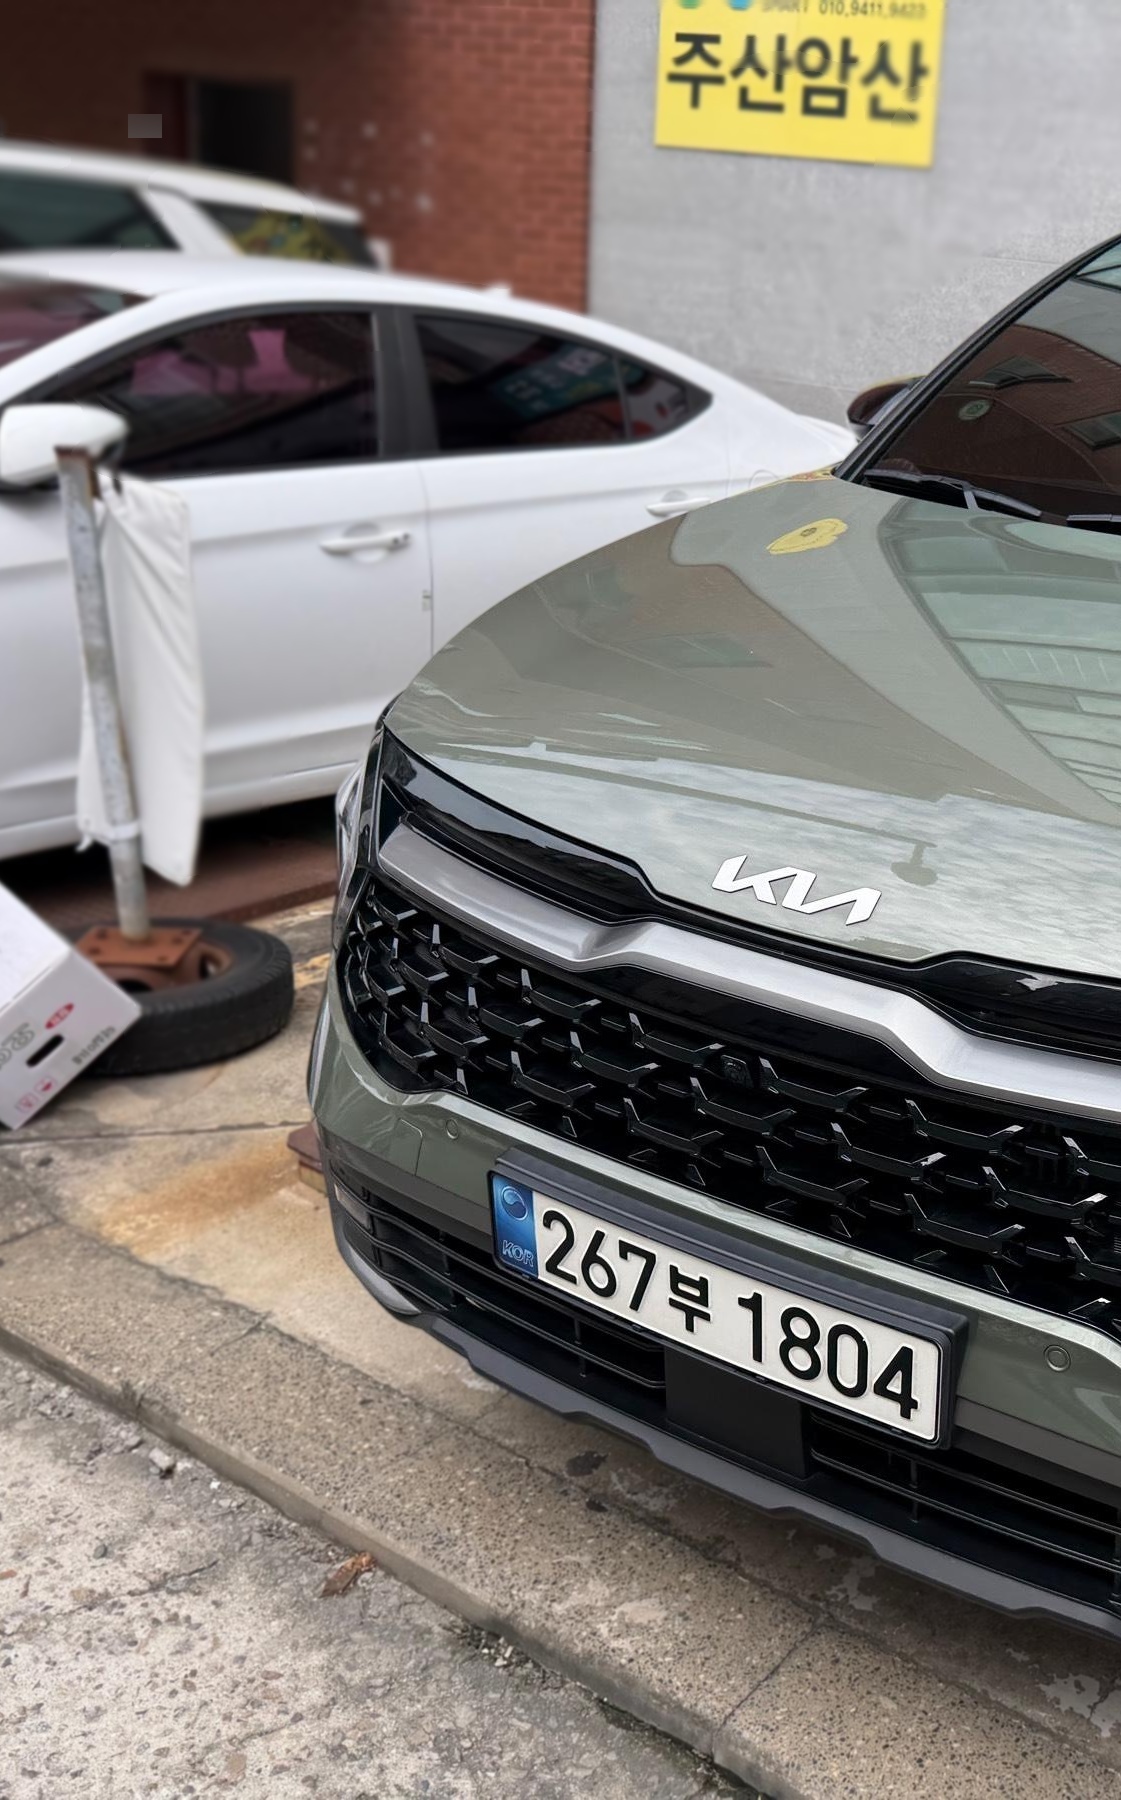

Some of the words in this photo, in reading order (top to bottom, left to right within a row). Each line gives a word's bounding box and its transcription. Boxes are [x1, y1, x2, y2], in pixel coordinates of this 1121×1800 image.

[666, 32, 929, 125] 주산암산
[711, 854, 883, 926] KIA
[502, 1239, 534, 1268] KOR
[541, 1209, 711, 1334] 267부
[737, 1291, 919, 1420] 1804
